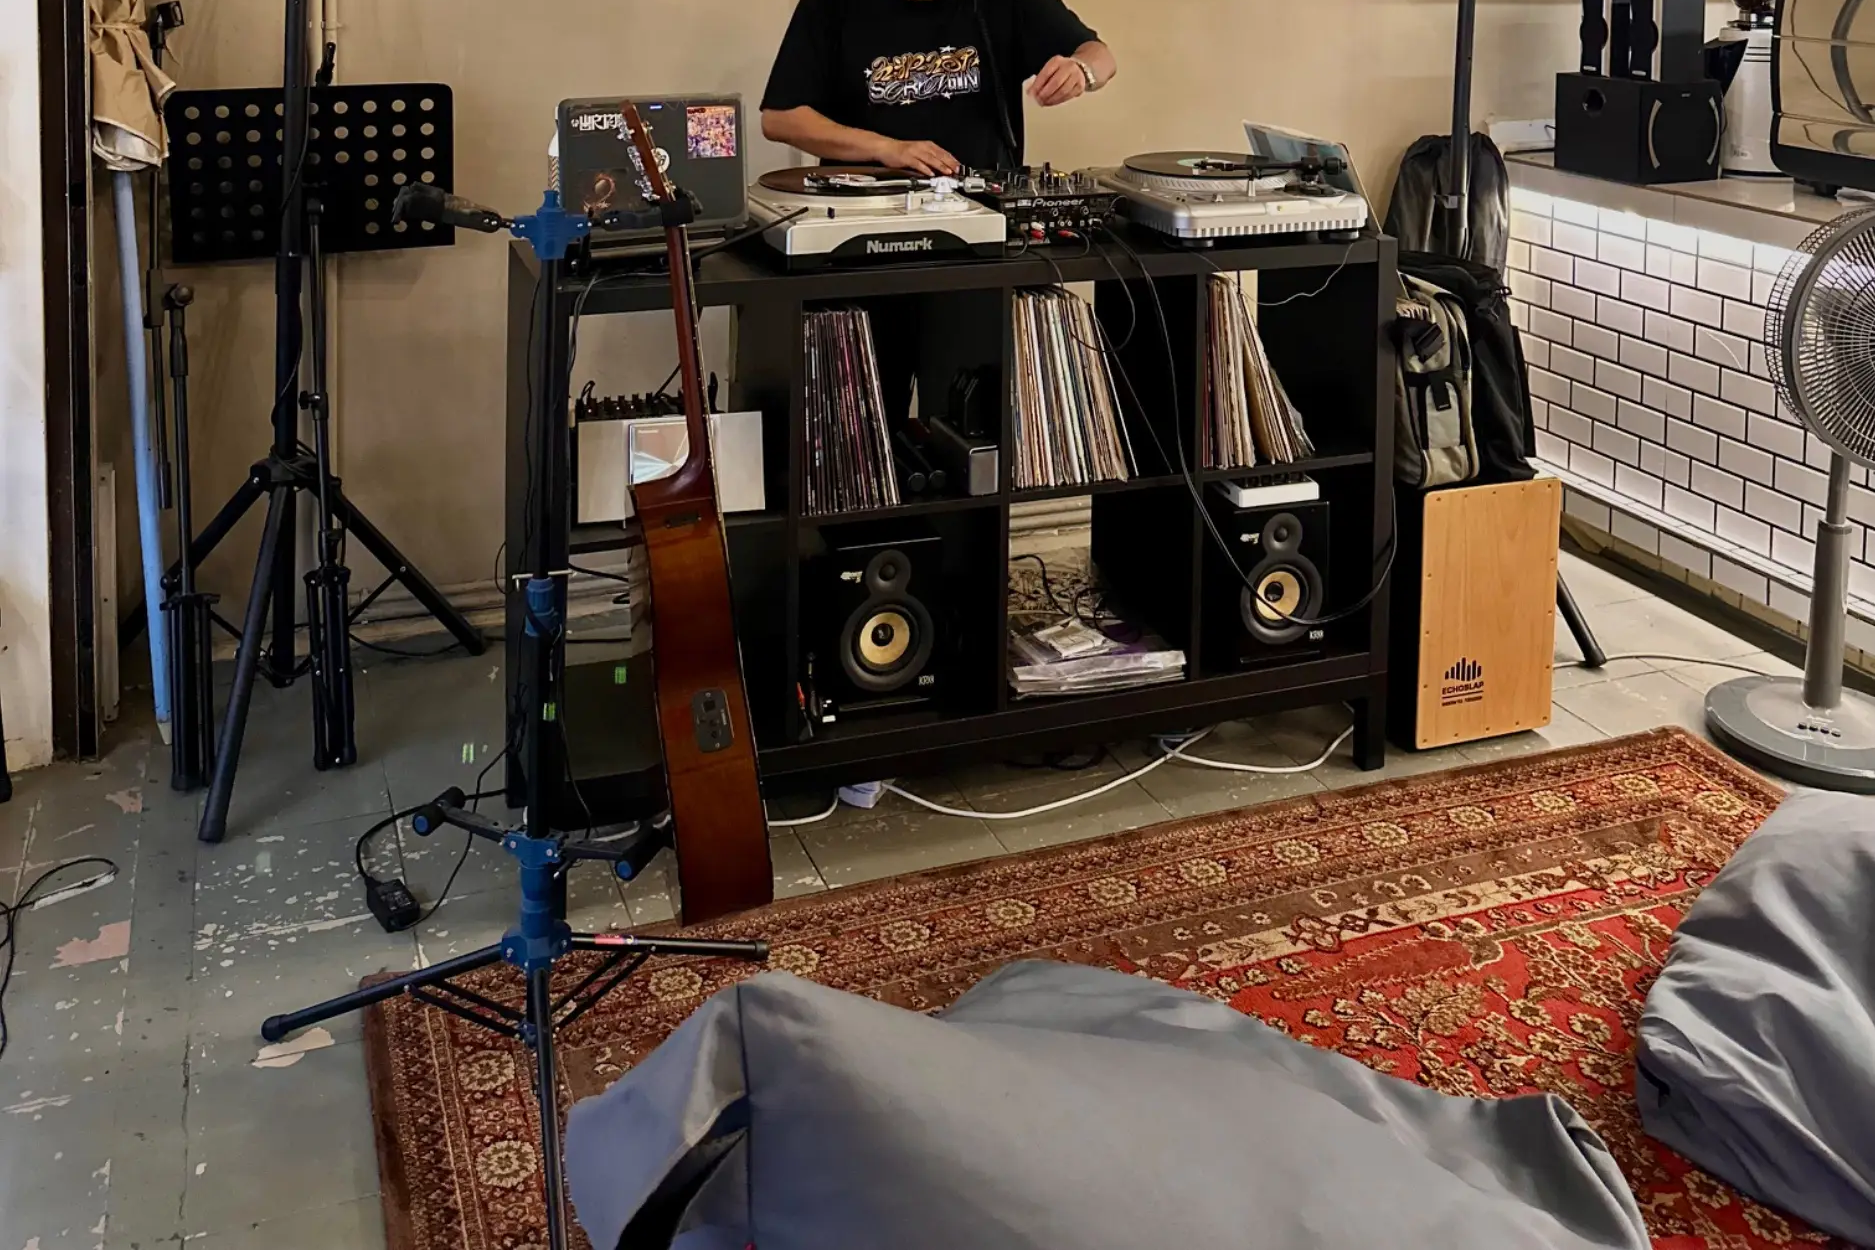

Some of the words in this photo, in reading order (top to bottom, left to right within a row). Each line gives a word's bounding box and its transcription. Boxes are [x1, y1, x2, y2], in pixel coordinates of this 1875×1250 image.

[1032, 198, 1085, 208] Pioneer
[866, 237, 933, 254] Numark
[1441, 681, 1485, 695] ECHOSLAP
